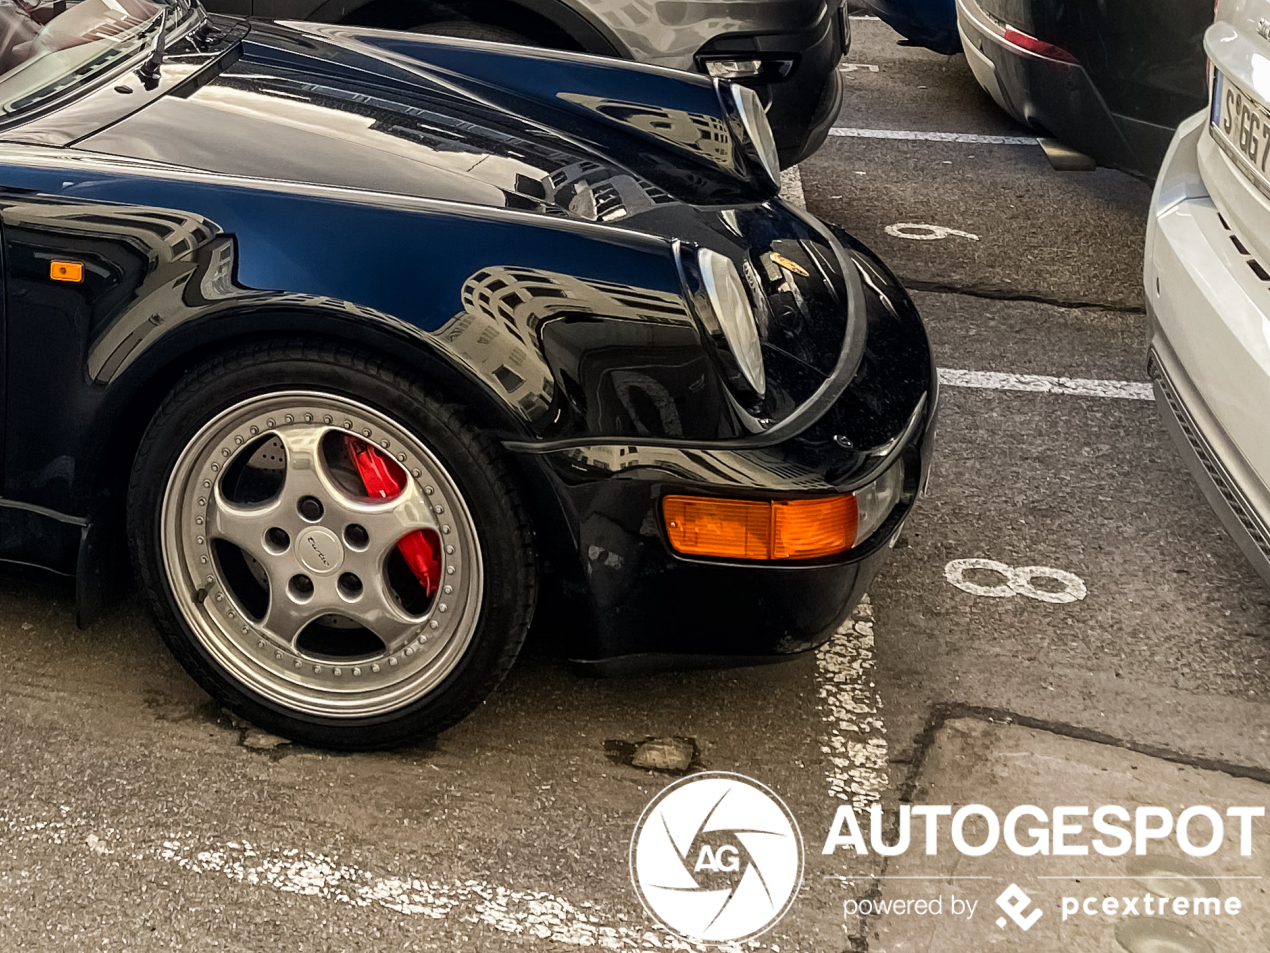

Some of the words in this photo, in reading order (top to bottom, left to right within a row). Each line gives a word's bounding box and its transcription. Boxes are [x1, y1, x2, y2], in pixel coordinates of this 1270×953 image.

[1223, 88, 1235, 136] S
[1240, 102, 1260, 166] GG
[944, 557, 1088, 605] 8
